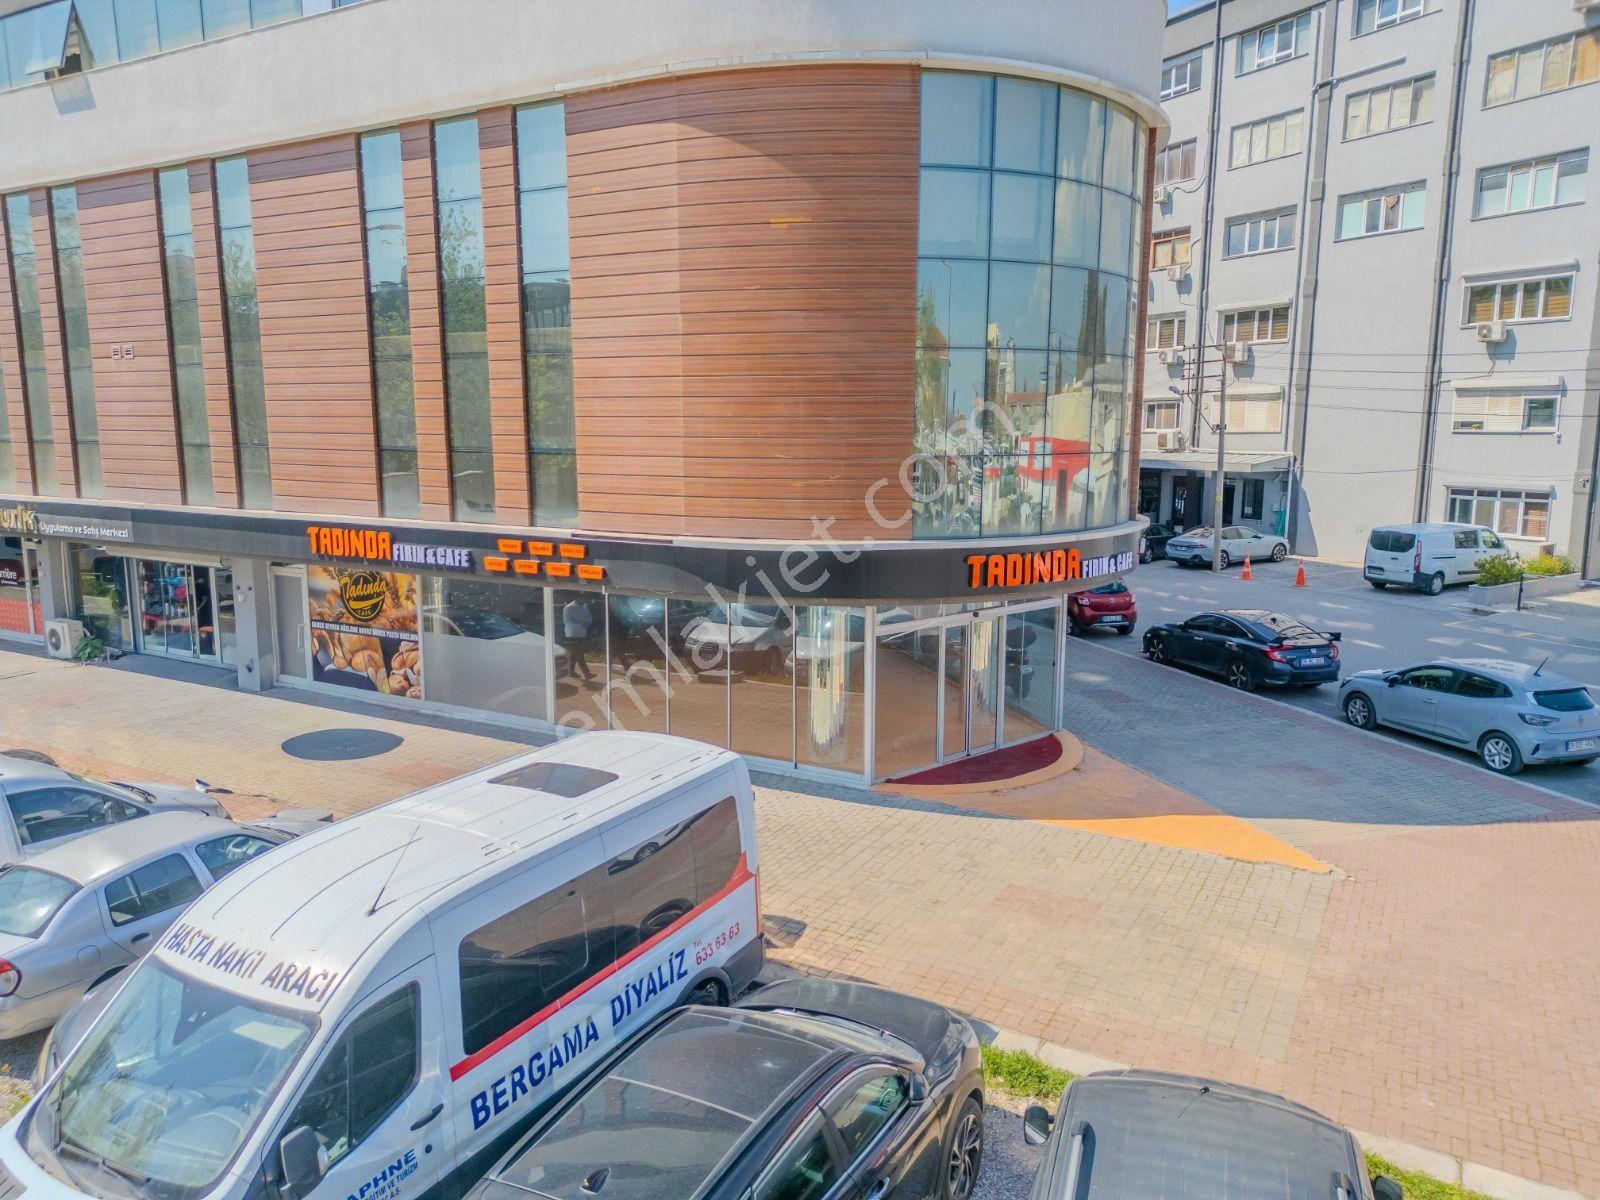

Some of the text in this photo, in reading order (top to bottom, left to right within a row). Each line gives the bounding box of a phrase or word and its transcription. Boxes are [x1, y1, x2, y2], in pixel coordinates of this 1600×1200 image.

[40, 522, 74, 534] Uygulama
[75, 526, 83, 534] ve
[100, 527, 129, 538] Merkezi
[306, 525, 391, 561] TADINDA
[967, 547, 1081, 589] TADINDA
[163, 923, 218, 964] HASTA
[261, 959, 338, 1002] ARACI
[695, 922, 740, 966] 633 63 63
[470, 947, 688, 1131] BERGAMA DİYALİZ
[386, 1179, 396, 1190] VE
